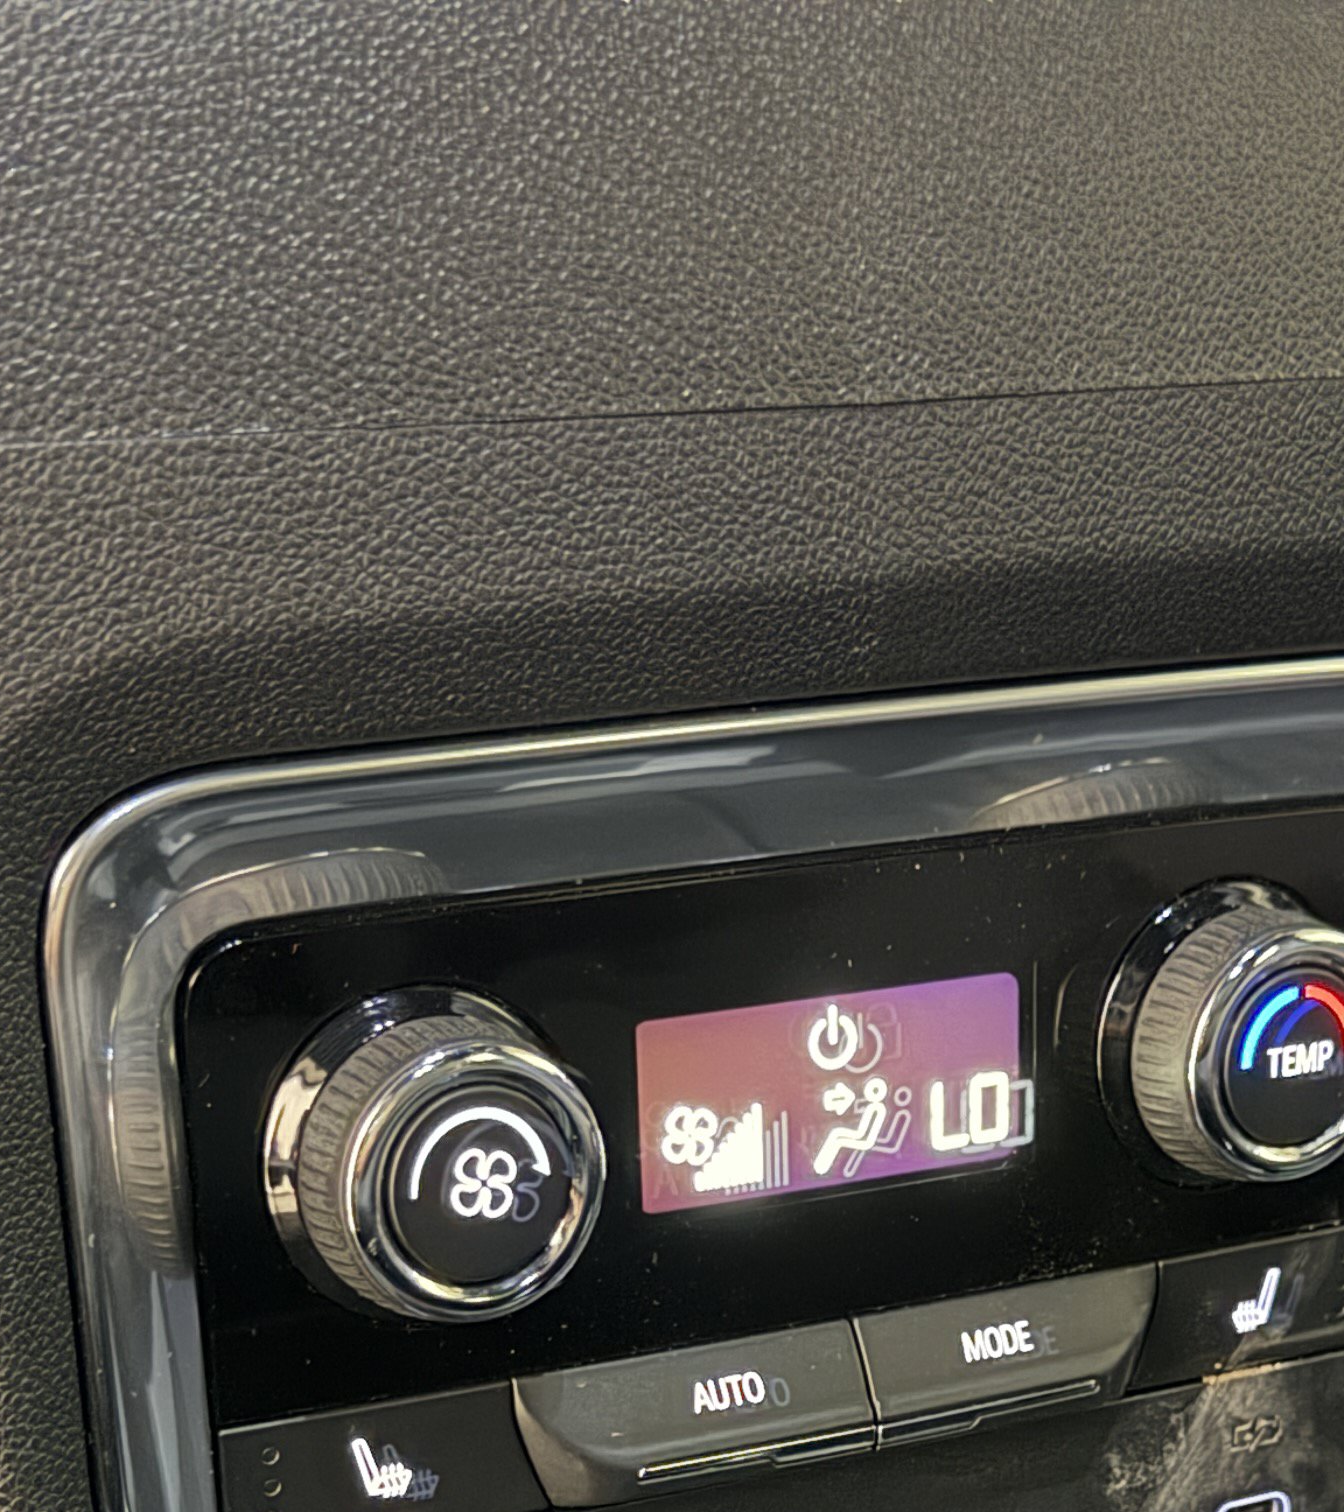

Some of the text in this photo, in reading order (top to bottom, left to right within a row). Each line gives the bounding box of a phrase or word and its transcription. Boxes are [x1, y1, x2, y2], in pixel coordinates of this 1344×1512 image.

[1265, 1039, 1335, 1079] TEMP
[929, 1070, 1010, 1152] LO
[960, 1319, 1035, 1363] MODE
[693, 1371, 766, 1415] AUTO
